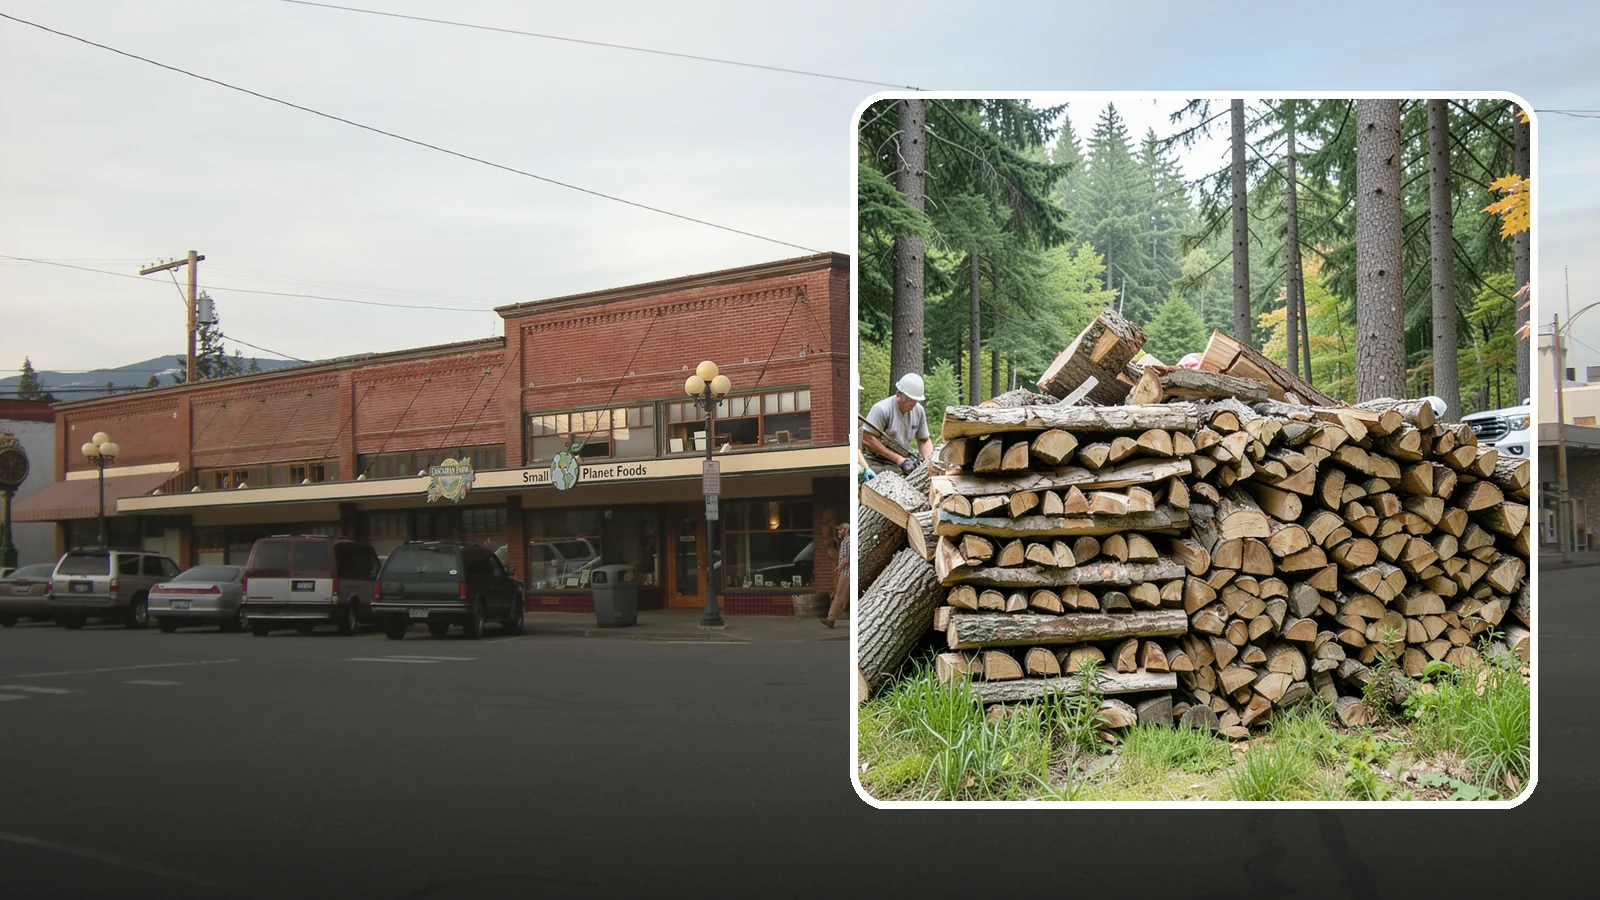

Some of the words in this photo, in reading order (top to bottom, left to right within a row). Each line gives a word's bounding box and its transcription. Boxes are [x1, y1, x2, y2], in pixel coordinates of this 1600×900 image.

[523, 471, 549, 483] Small
[583, 467, 614, 479] Planet
[617, 464, 647, 477] Foods
